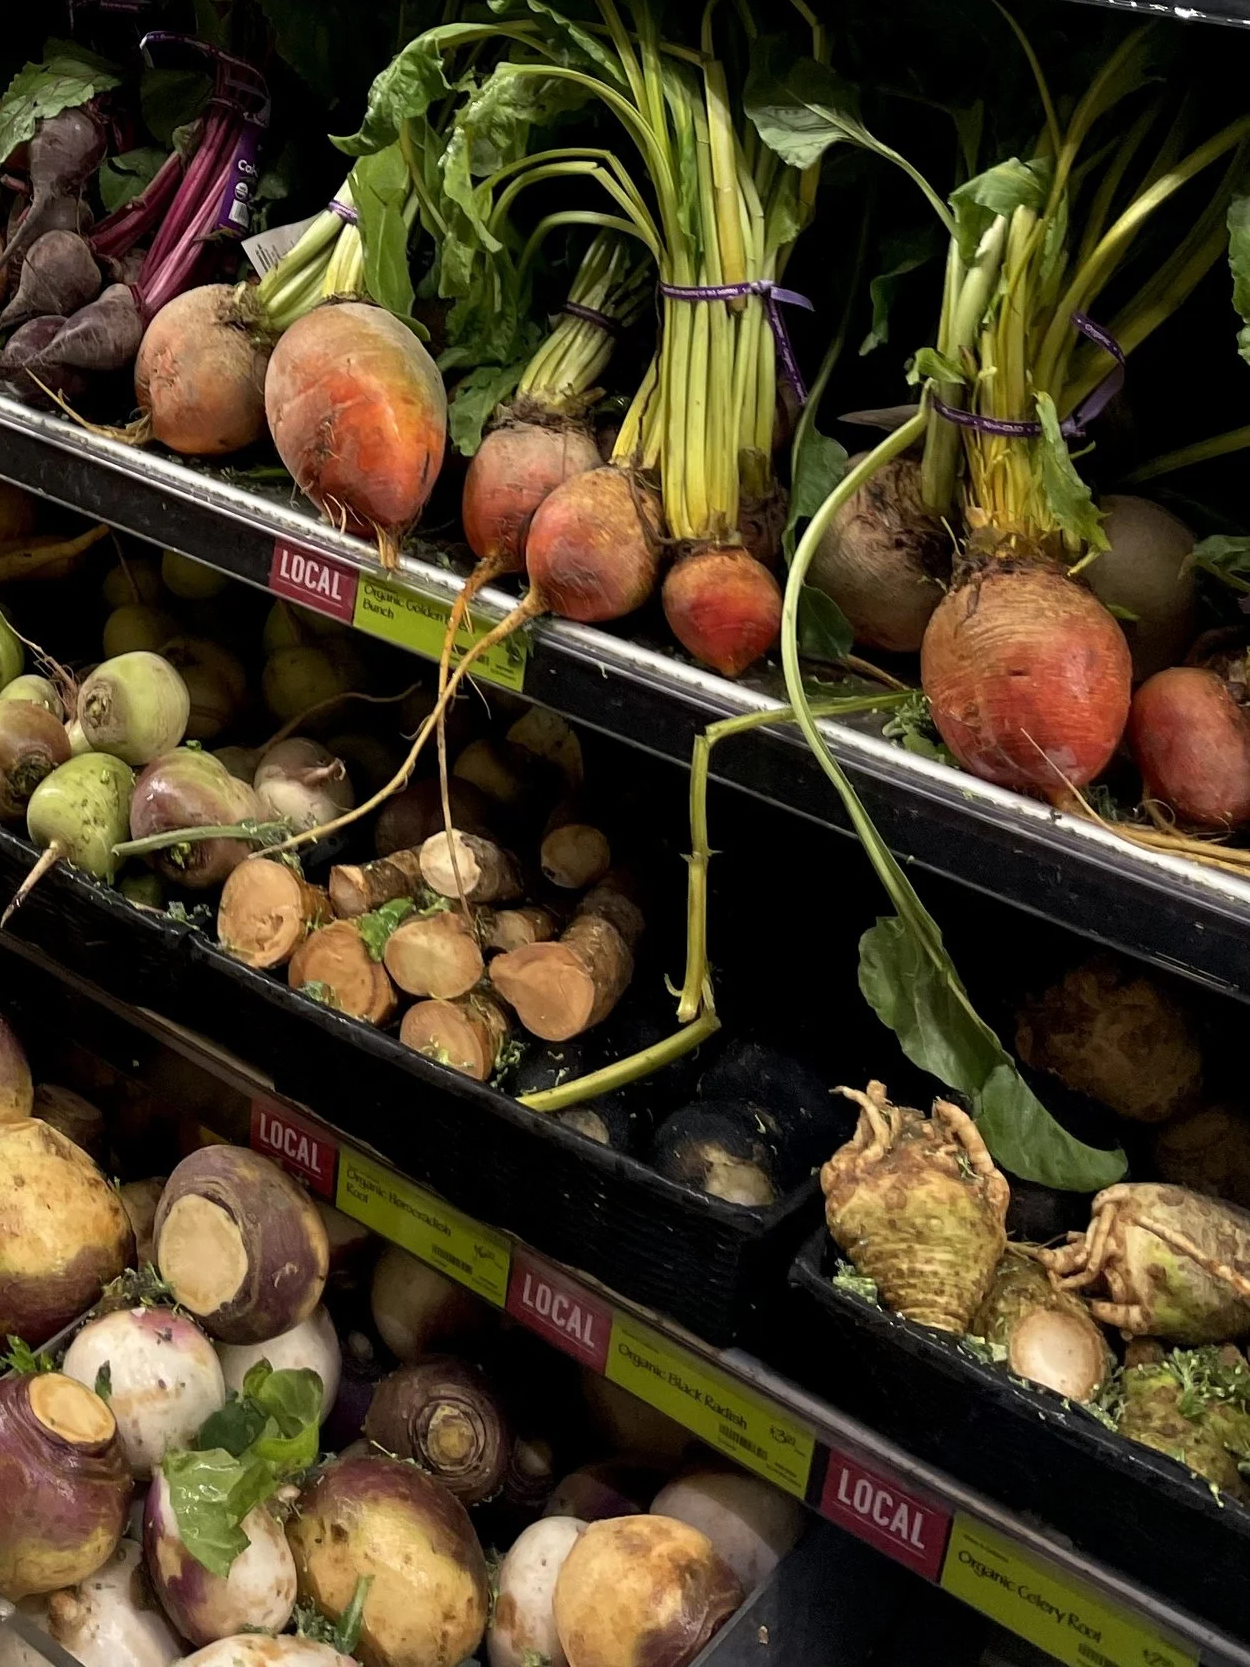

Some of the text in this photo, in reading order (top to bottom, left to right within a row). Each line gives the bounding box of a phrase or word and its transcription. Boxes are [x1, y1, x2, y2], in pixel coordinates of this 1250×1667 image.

[280, 550, 342, 601] LOCAL
[364, 584, 402, 608] Organic
[406, 599, 446, 622] Golden
[362, 597, 394, 620] Bunch
[260, 1113, 322, 1173] LOCAL
[346, 1183, 369, 1204] Root
[346, 1168, 452, 1237] Organic Horseradish
[522, 1273, 596, 1348] LOCAL
[618, 1343, 748, 1431] Organic Black Radish
[837, 1467, 926, 1550] LOCAL
[958, 1550, 1102, 1645] Organic Celery Root
